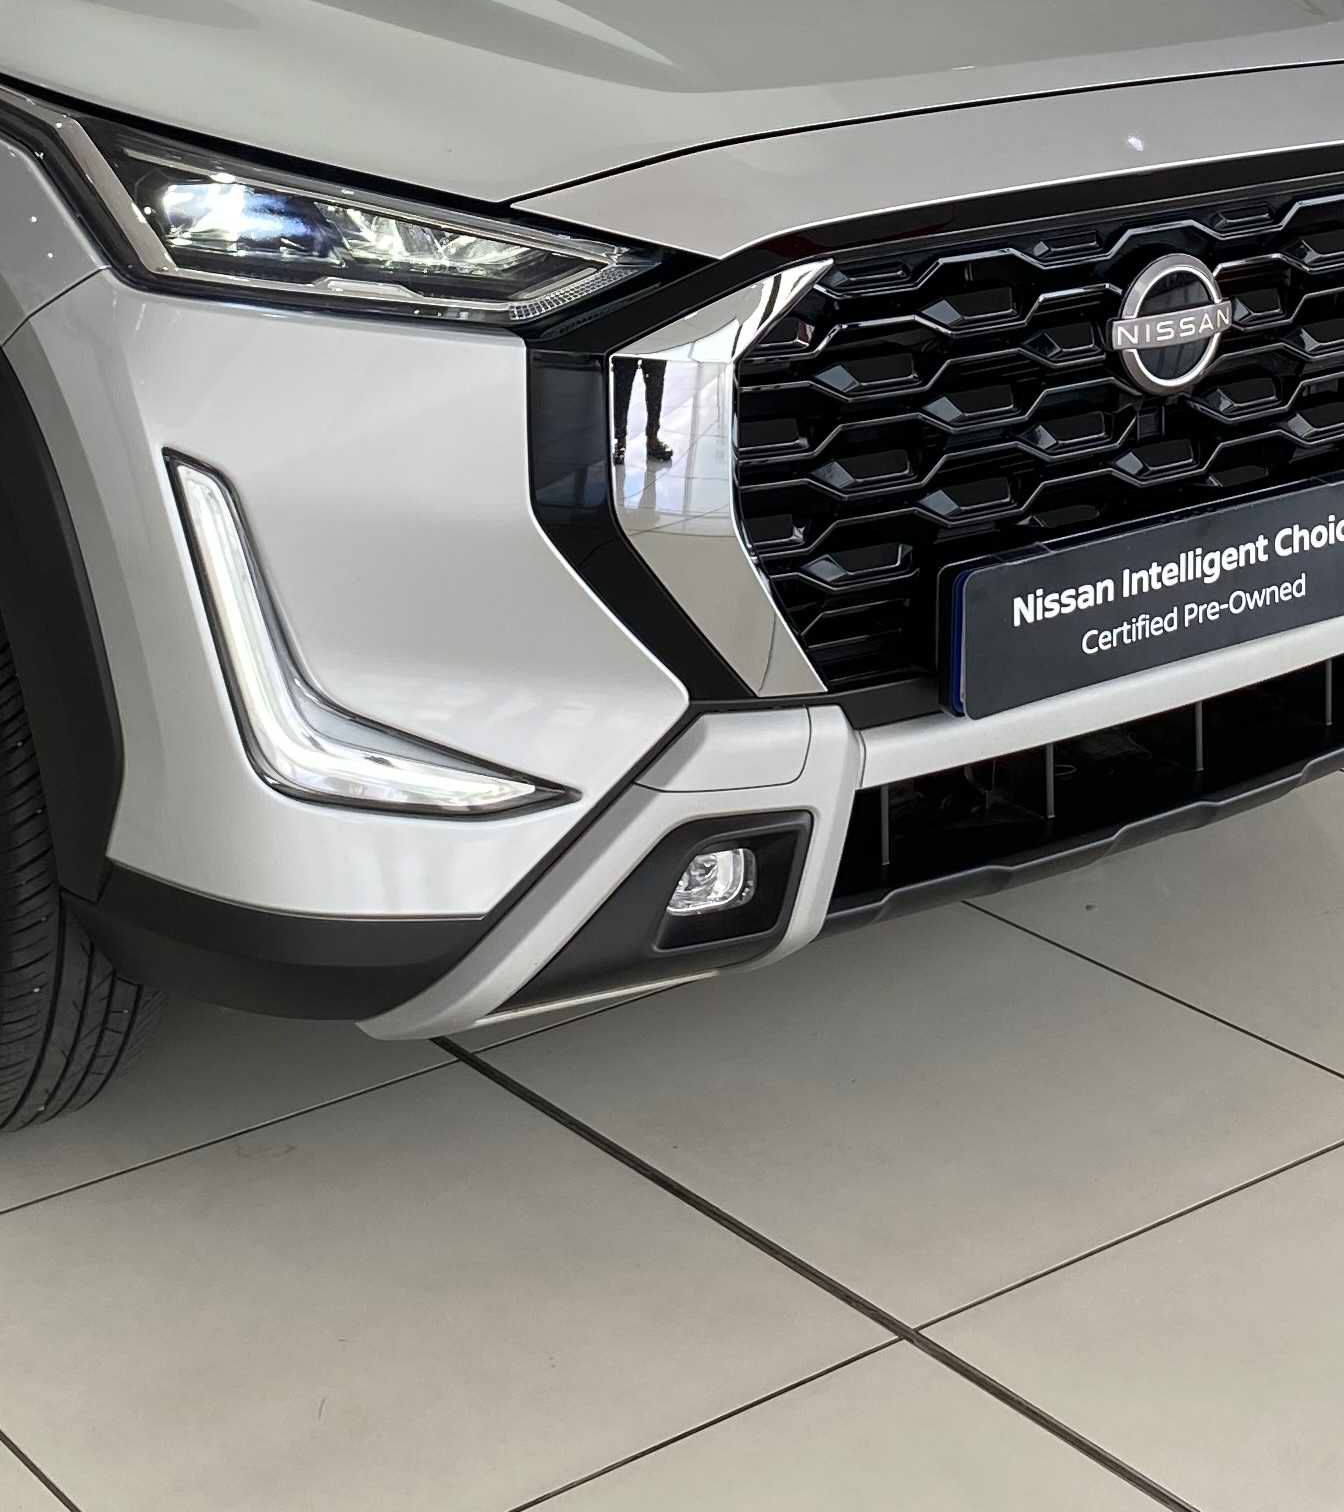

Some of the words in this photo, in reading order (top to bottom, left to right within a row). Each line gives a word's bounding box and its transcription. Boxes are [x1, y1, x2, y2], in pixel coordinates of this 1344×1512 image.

[1116, 305, 1231, 347] NISSAN
[1013, 580, 1114, 627] Nissan
[1122, 535, 1270, 595] Intelligent
[1081, 606, 1179, 655] Certified
[1184, 573, 1307, 629] Pre-Owned
